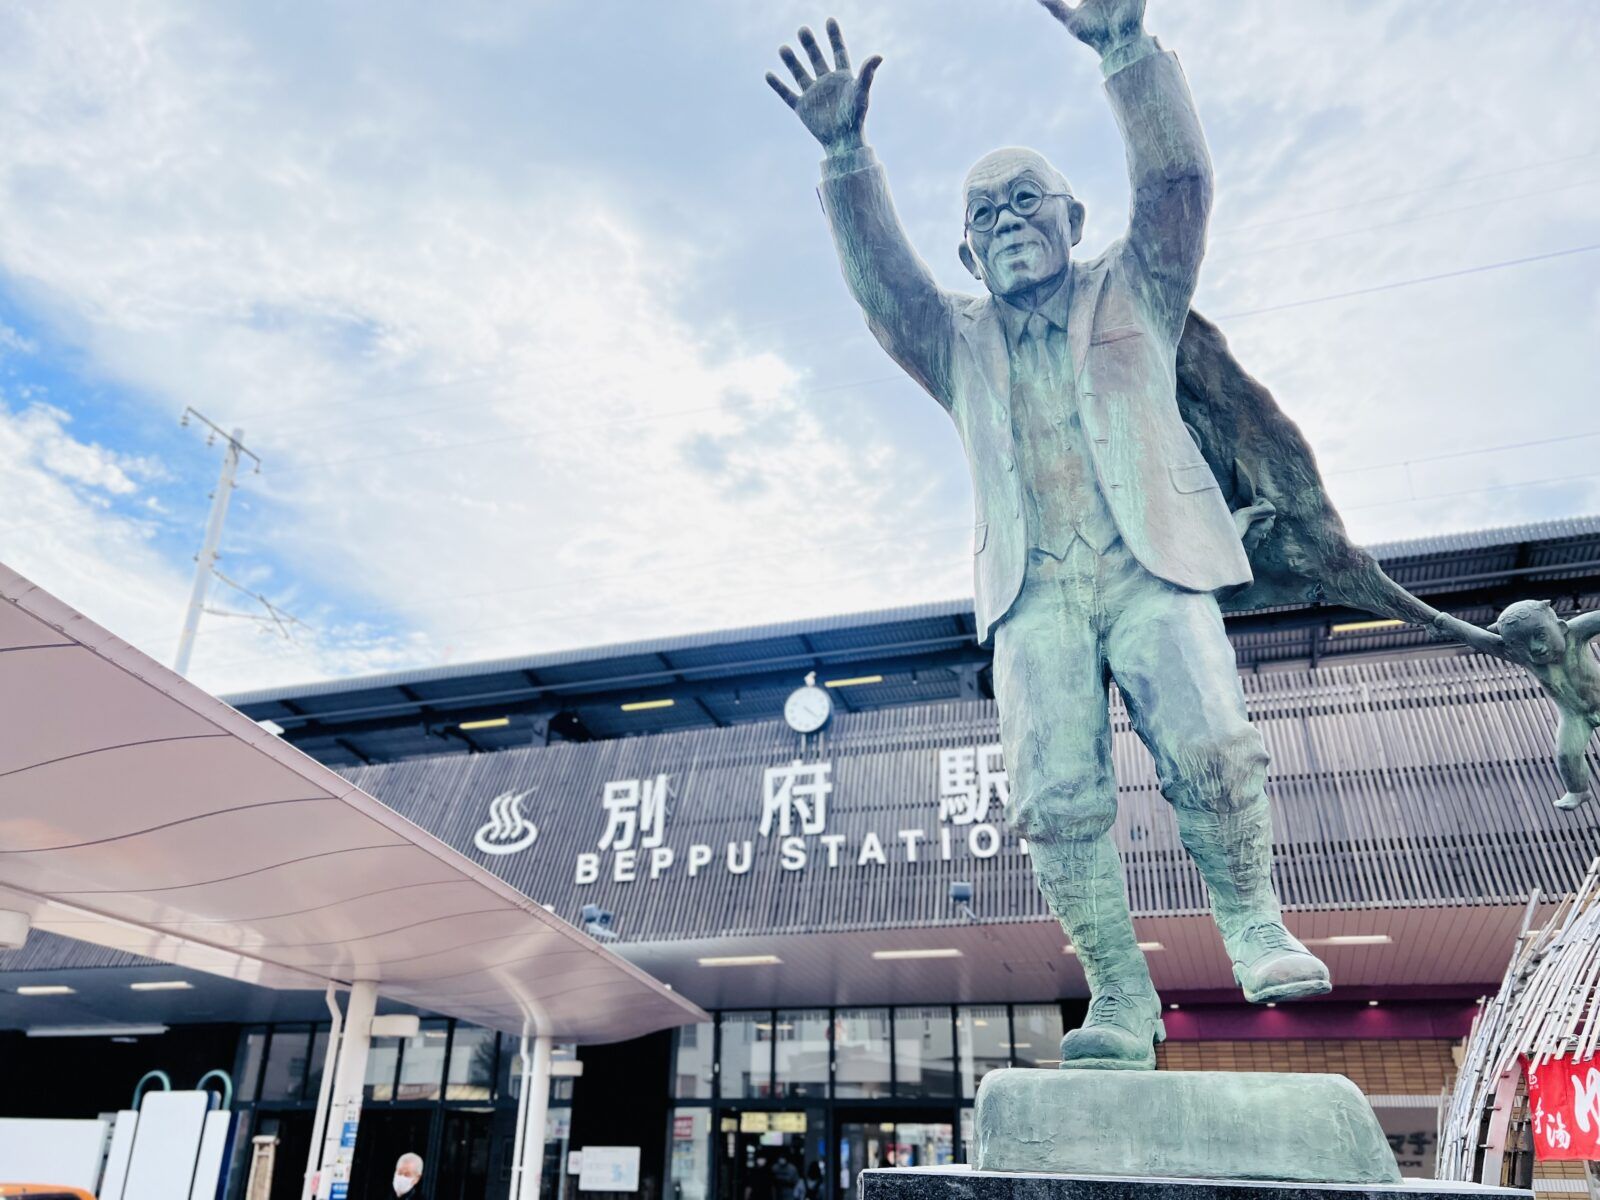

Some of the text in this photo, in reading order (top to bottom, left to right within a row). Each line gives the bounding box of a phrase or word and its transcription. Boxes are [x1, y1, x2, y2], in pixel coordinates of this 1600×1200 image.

[597, 744, 1009, 851] 別府駅
[575, 823, 1029, 885] BEPPU STATIO
